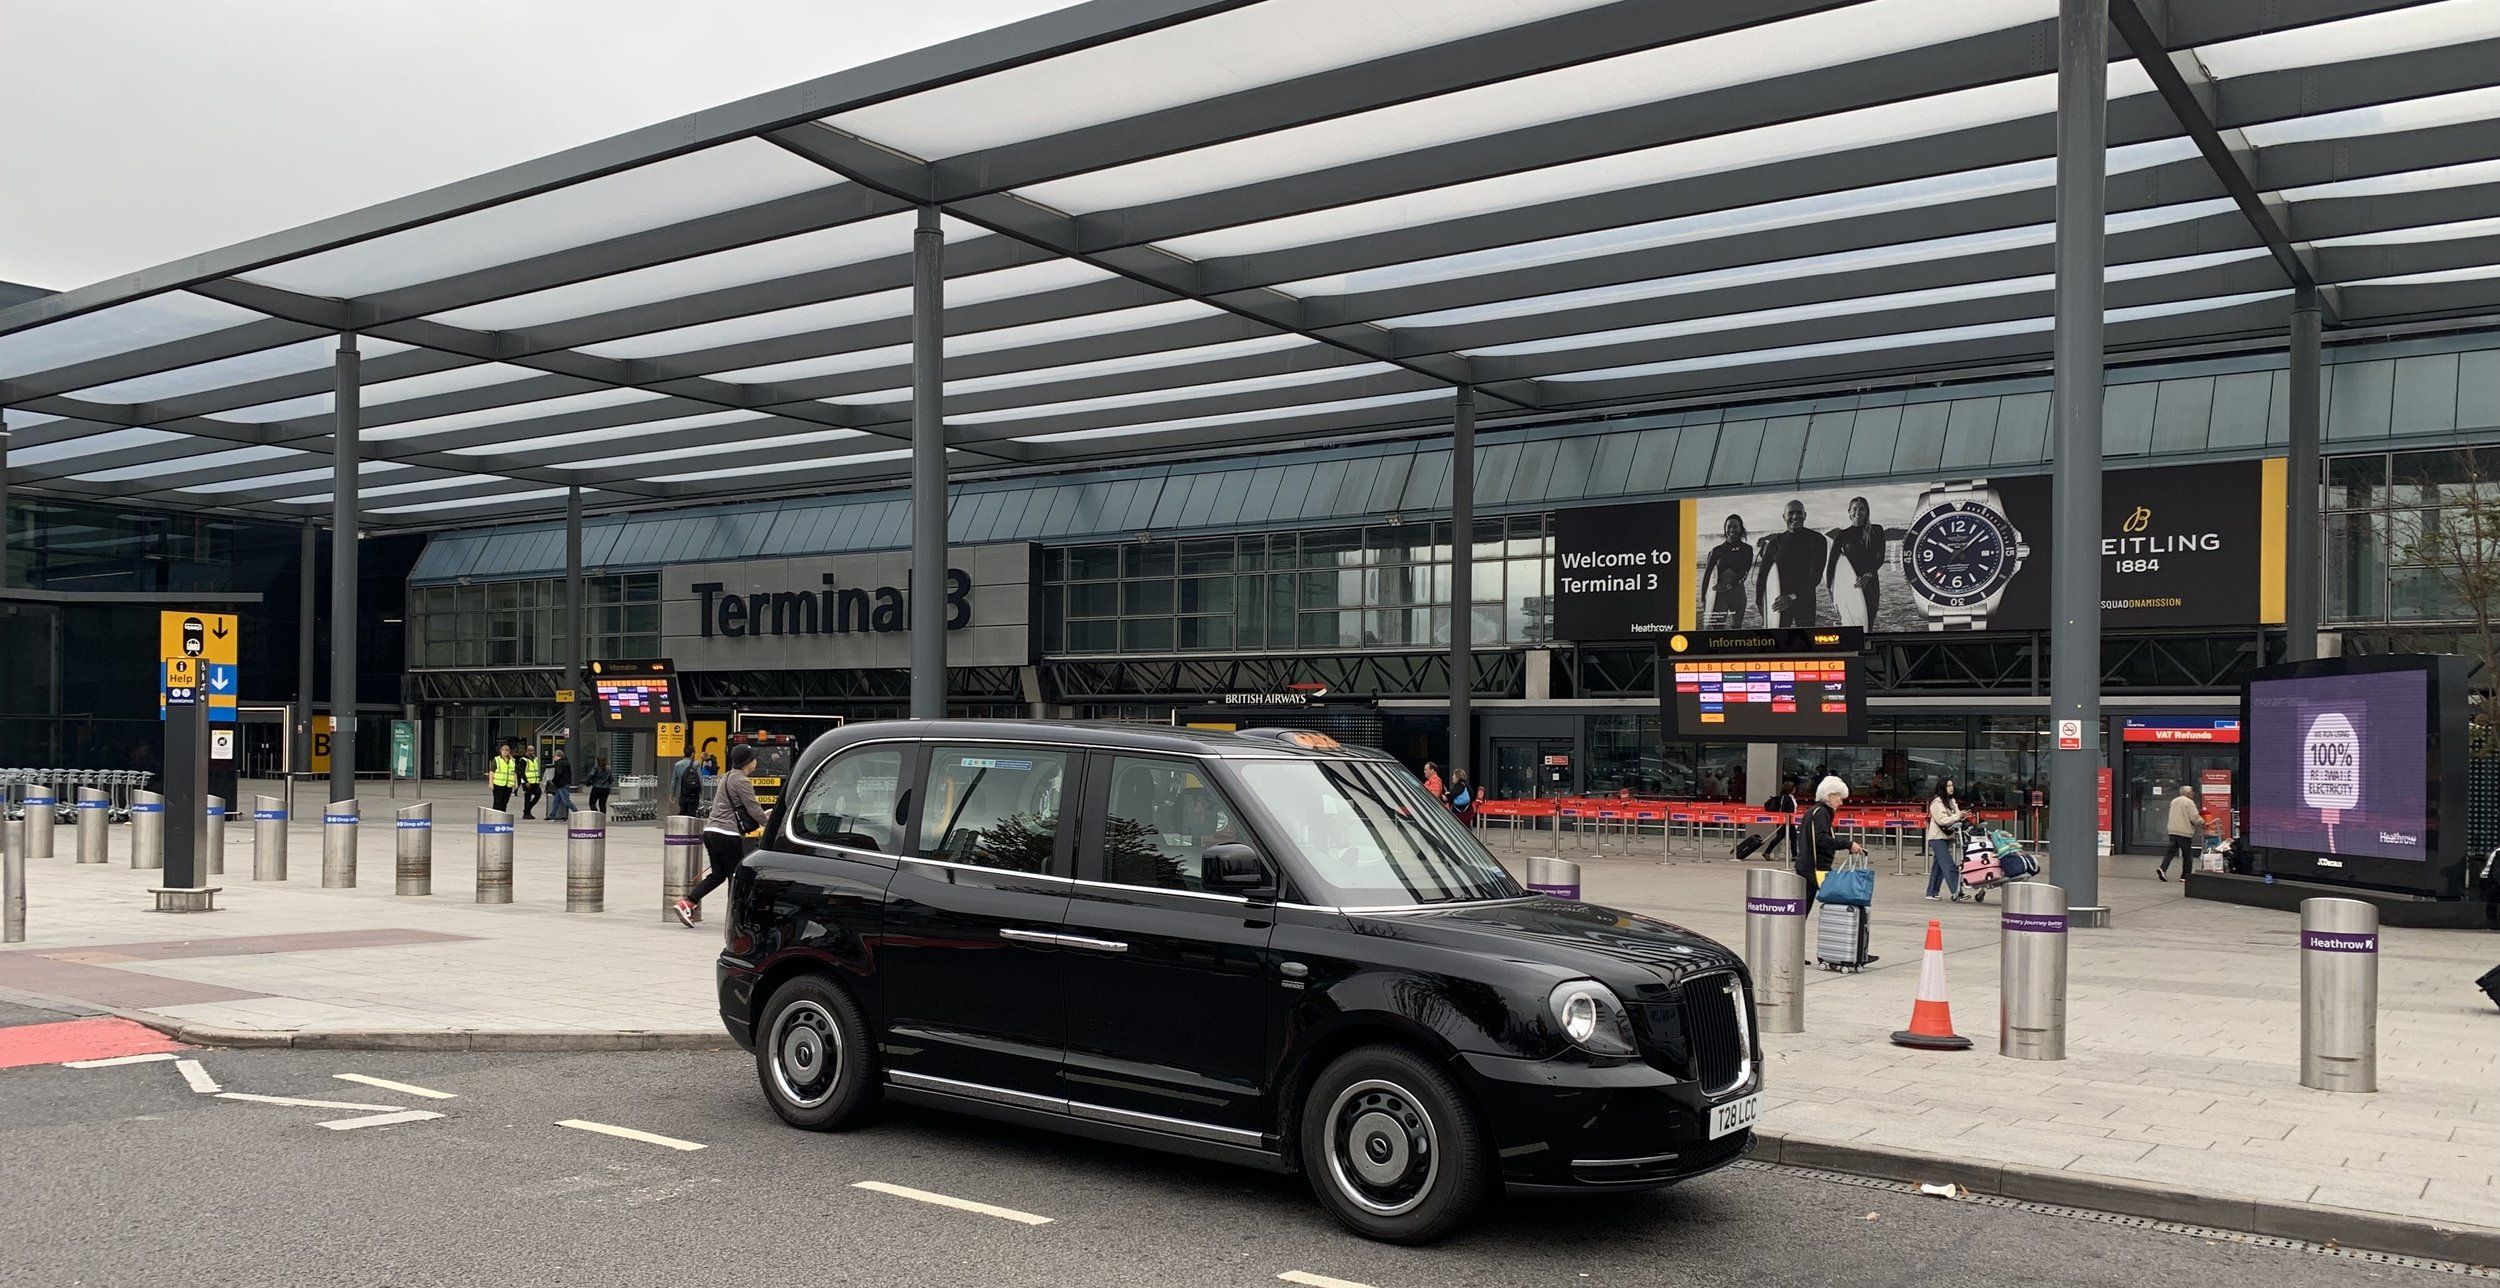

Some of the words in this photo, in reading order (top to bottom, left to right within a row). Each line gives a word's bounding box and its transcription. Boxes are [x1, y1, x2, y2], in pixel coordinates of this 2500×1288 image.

[1951, 521, 1965, 532] 12
[2101, 533, 2221, 556] EITLING
[1561, 551, 1646, 569] Welcome
[1651, 549, 1672, 565] to
[1923, 550, 1934, 562] 9
[2116, 559, 2159, 573] 1884
[1561, 574, 1641, 593] Terminal
[1647, 573, 1658, 590] 3
[1952, 576, 1963, 588] 6
[946, 568, 971, 631] 3
[2101, 598, 2182, 609] SQUADONAMISSION
[1631, 623, 1673, 632] Heathrow
[1709, 637, 1775, 648] Information
[170, 675, 193, 684] Help
[1225, 694, 1263, 704] BRITISH
[1265, 694, 1307, 704] AIRWAYS
[2155, 731, 2171, 739] VAT
[2174, 731, 2213, 739] Refunds
[314, 733, 330, 757] B
[2311, 743, 2352, 767] 100%
[2379, 831, 2416, 845] Heathrow
[1747, 901, 1786, 912] Heathrow
[2310, 937, 2364, 950] Heathrow
[1718, 1104, 1737, 1132] T28
[1738, 1097, 1757, 1125] LCC
